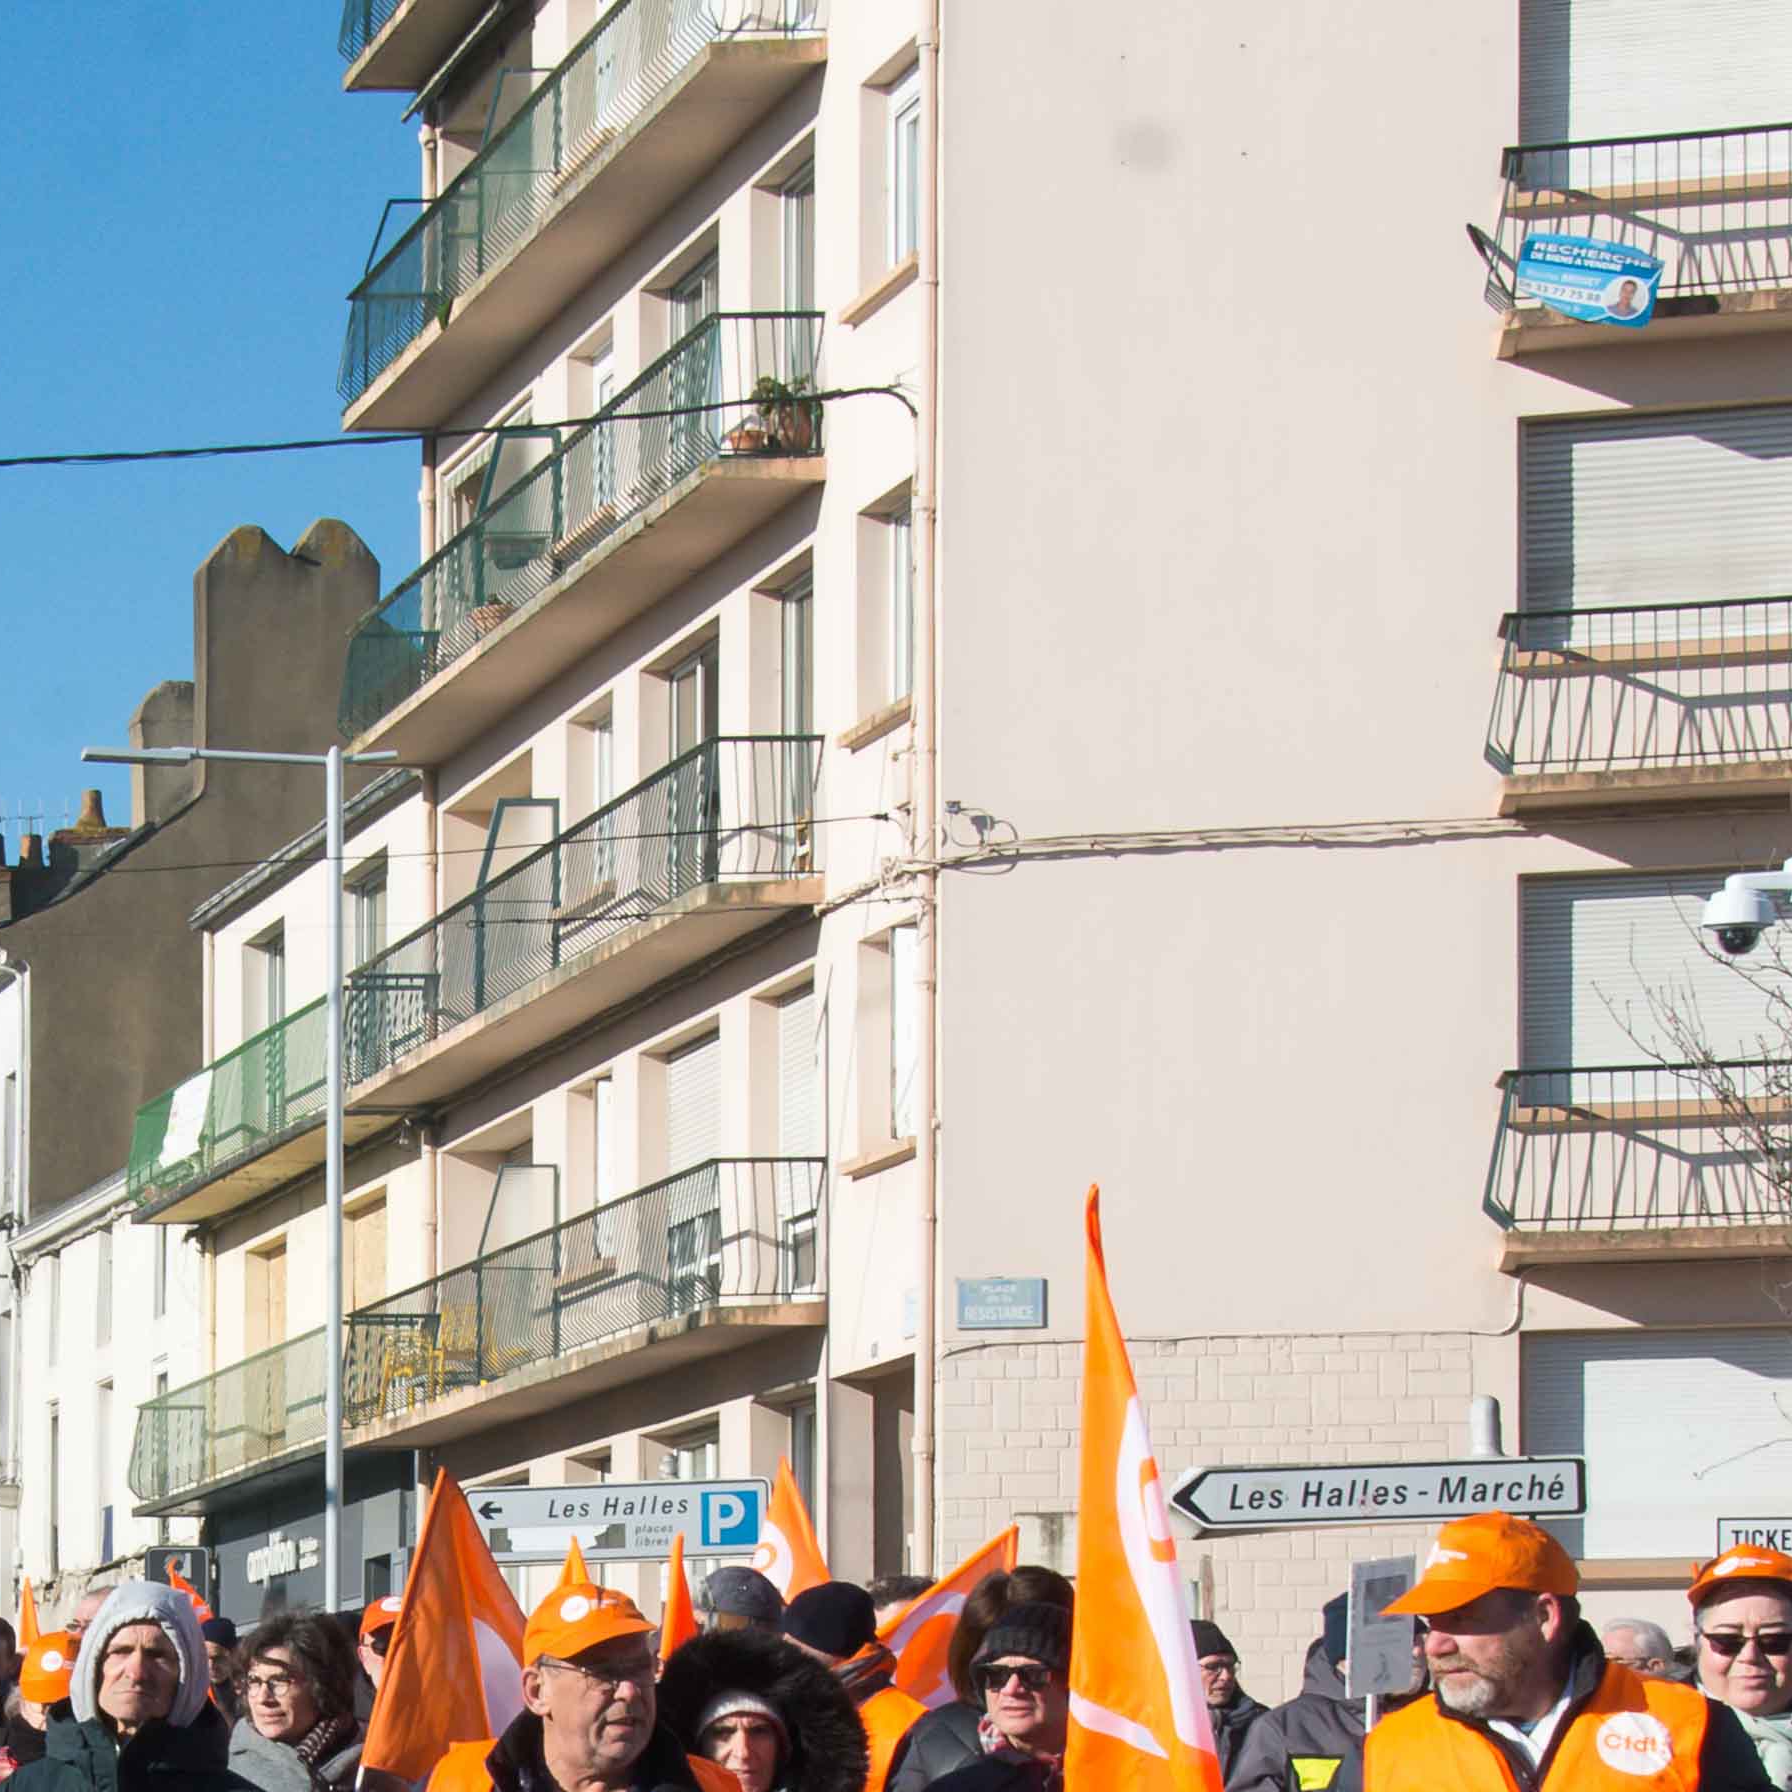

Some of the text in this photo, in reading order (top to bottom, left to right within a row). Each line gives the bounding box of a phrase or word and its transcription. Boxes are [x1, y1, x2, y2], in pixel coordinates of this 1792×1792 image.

[1533, 241, 1653, 269] RECHERCHE
[1228, 1483, 1286, 1511] Les
[1300, 1478, 1409, 1508] Halles
[1437, 1472, 1566, 1506] Marché
[548, 1499, 591, 1519] Les
[602, 1495, 689, 1518] Halles
